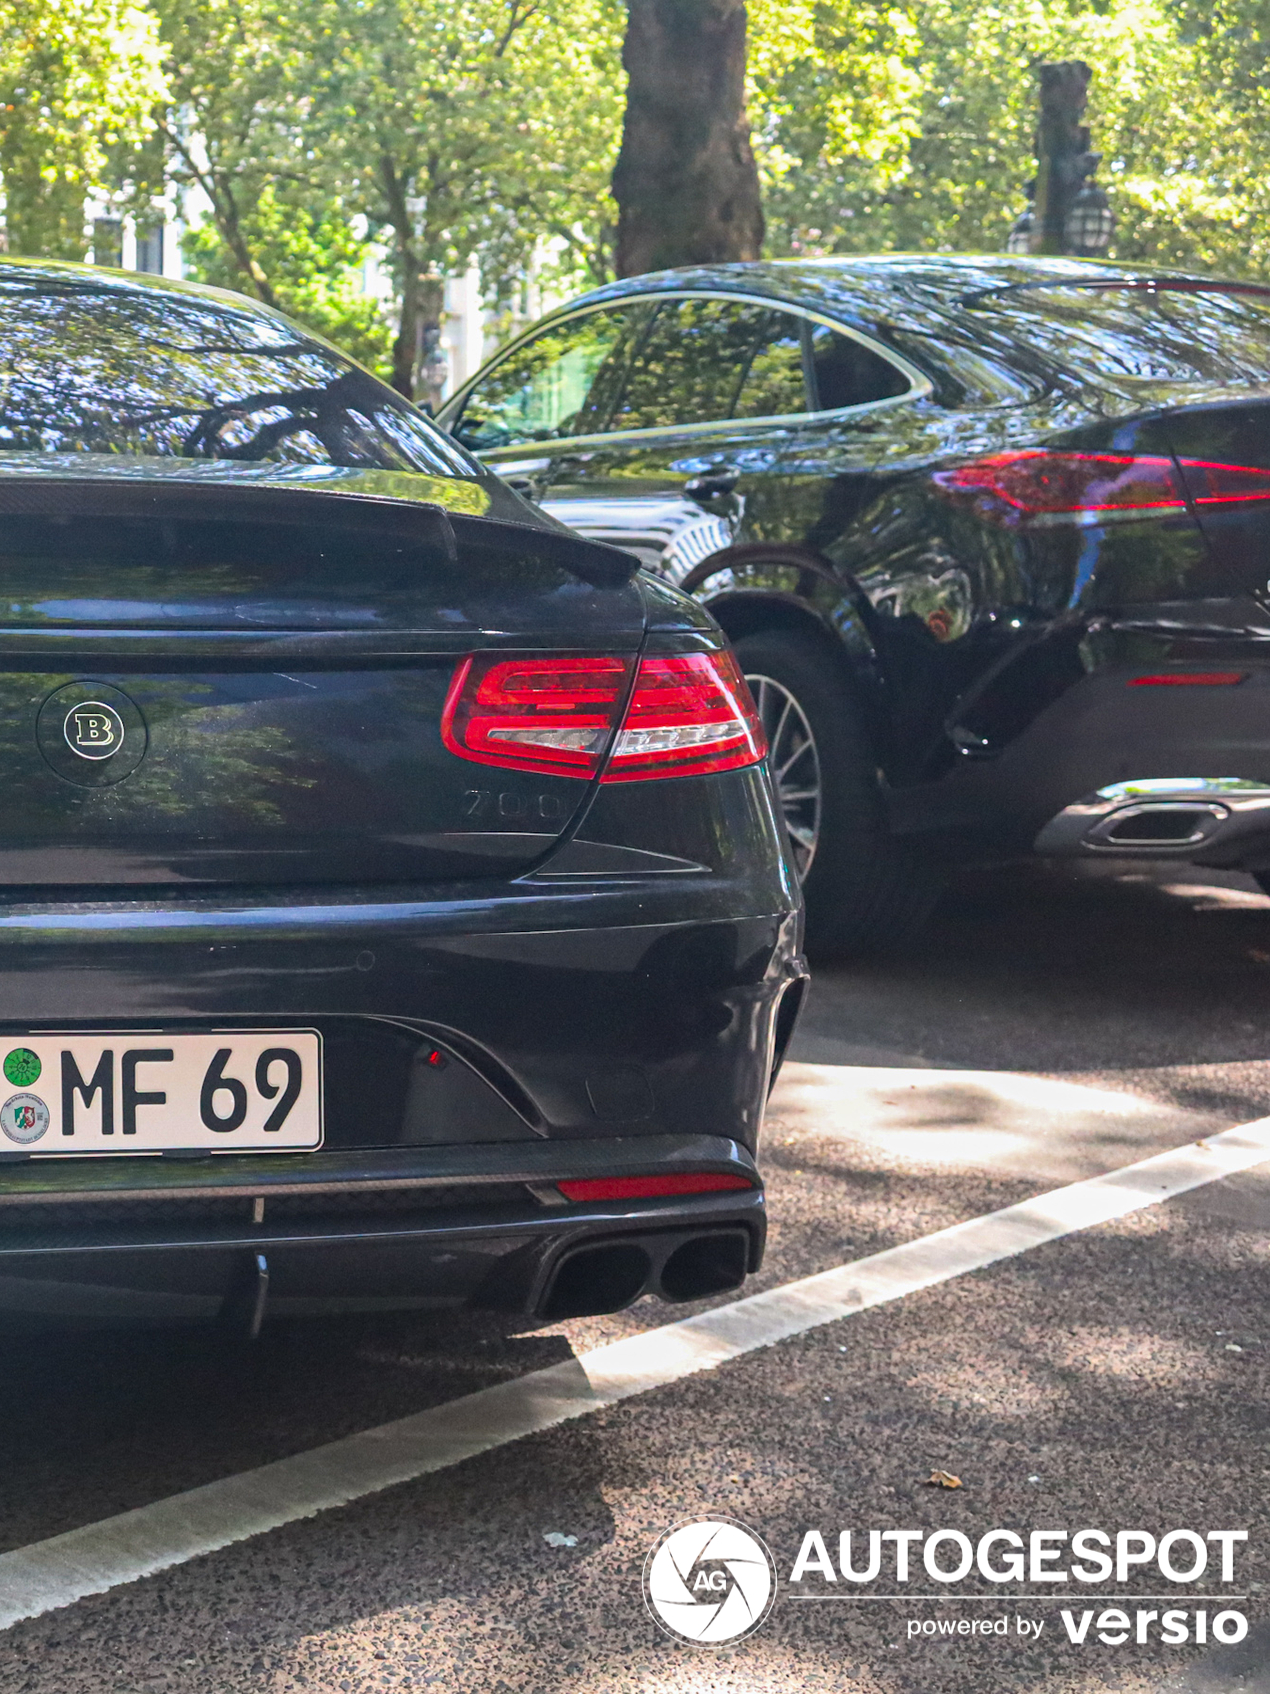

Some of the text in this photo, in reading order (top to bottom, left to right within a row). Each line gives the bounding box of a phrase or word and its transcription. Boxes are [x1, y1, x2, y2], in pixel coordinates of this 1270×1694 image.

[75, 713, 114, 745] B
[465, 790, 568, 817] 700
[61, 1048, 174, 1136] MF
[200, 1047, 302, 1133] 69
